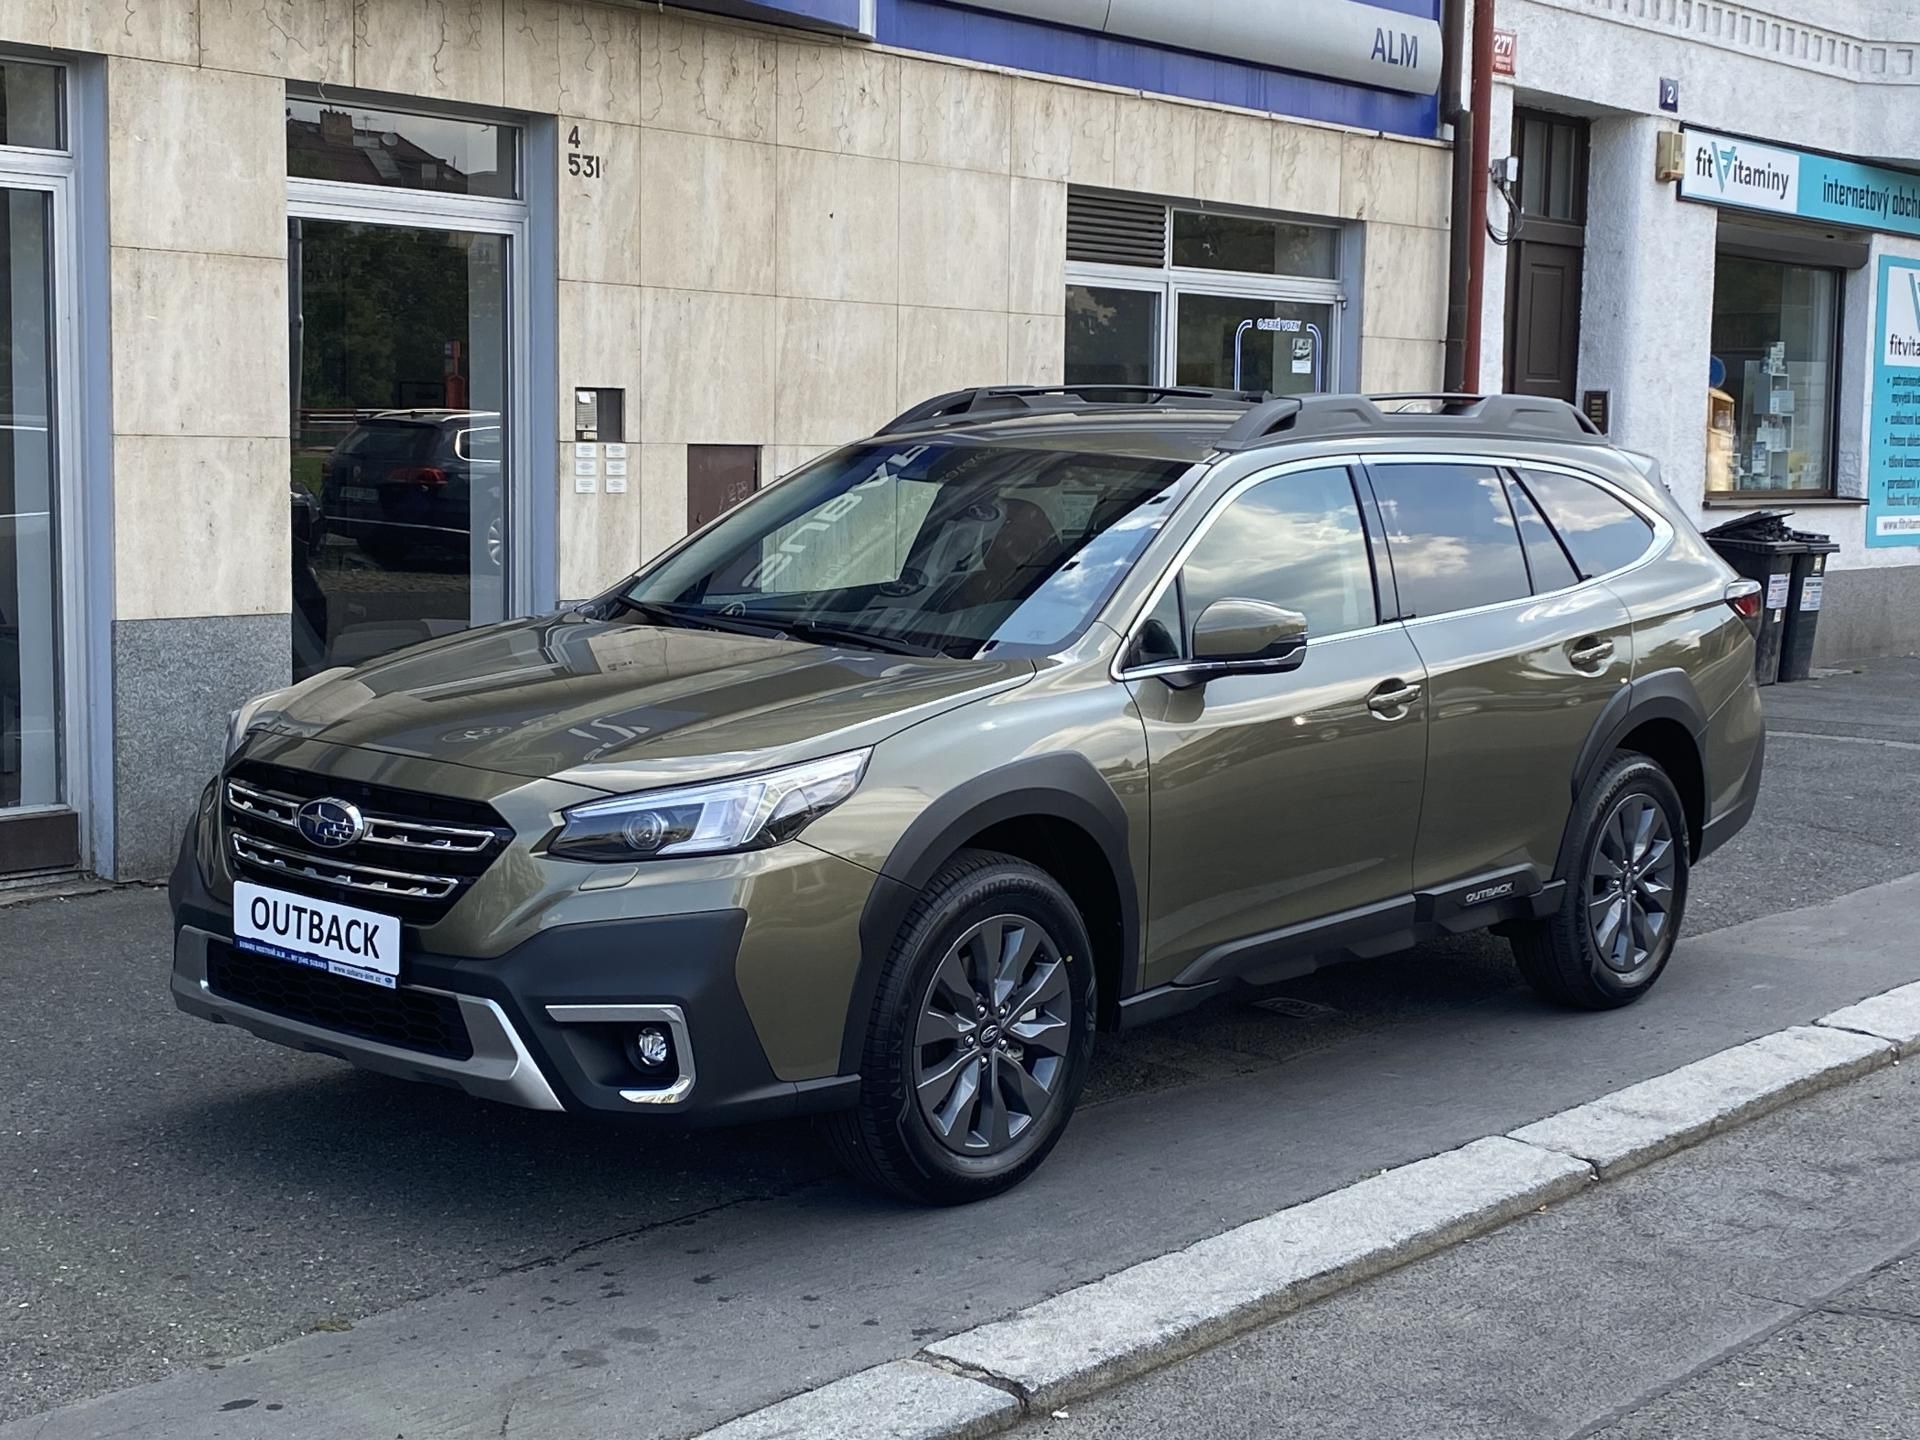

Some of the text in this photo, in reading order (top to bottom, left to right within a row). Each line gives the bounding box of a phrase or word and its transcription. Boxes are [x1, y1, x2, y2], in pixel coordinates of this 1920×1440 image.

[1371, 27, 1418, 69] ALM
[1494, 34, 1512, 56] 277
[1667, 86, 1675, 103] 2
[567, 126, 581, 149] 4
[567, 153, 600, 178] 531
[1823, 175, 1890, 220] internetový
[1465, 882, 1513, 903] OUTBACK
[251, 897, 380, 959] OUTBACK
